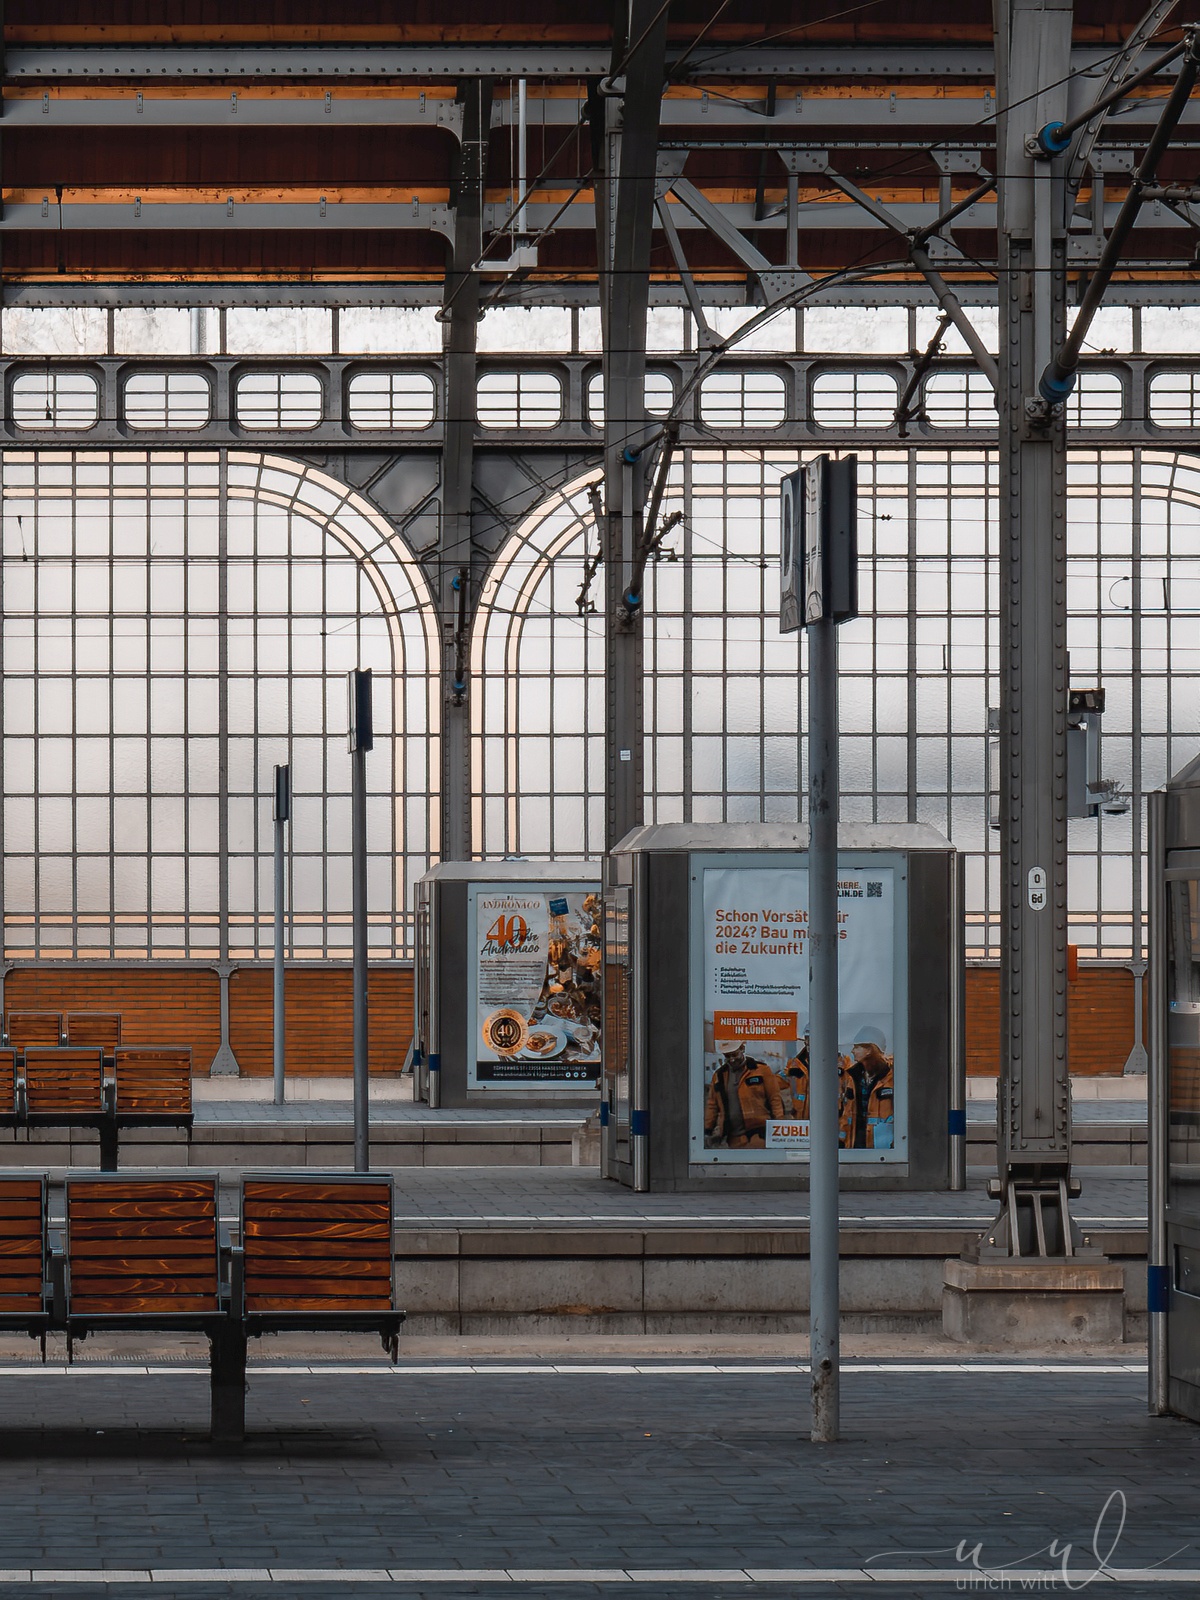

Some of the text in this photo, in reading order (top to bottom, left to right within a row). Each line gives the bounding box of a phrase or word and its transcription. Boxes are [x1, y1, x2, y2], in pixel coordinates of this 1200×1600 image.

[836, 881, 862, 889] RIERE.
[480, 900, 541, 910] ANDRONACO
[715, 909, 759, 922] Schon
[762, 909, 809, 923] Vorsät
[486, 914, 528, 947] 40
[715, 925, 810, 939] 2024? Bau mi
[480, 939, 541, 956] Andronaco
[715, 941, 804, 955] die Zukunft!
[720, 1017, 792, 1027] NEUER STANDORT
[497, 1024, 513, 1037] 40
[735, 1024, 777, 1035] IN LÜBECK
[771, 1125, 809, 1137] ZÜBLI
